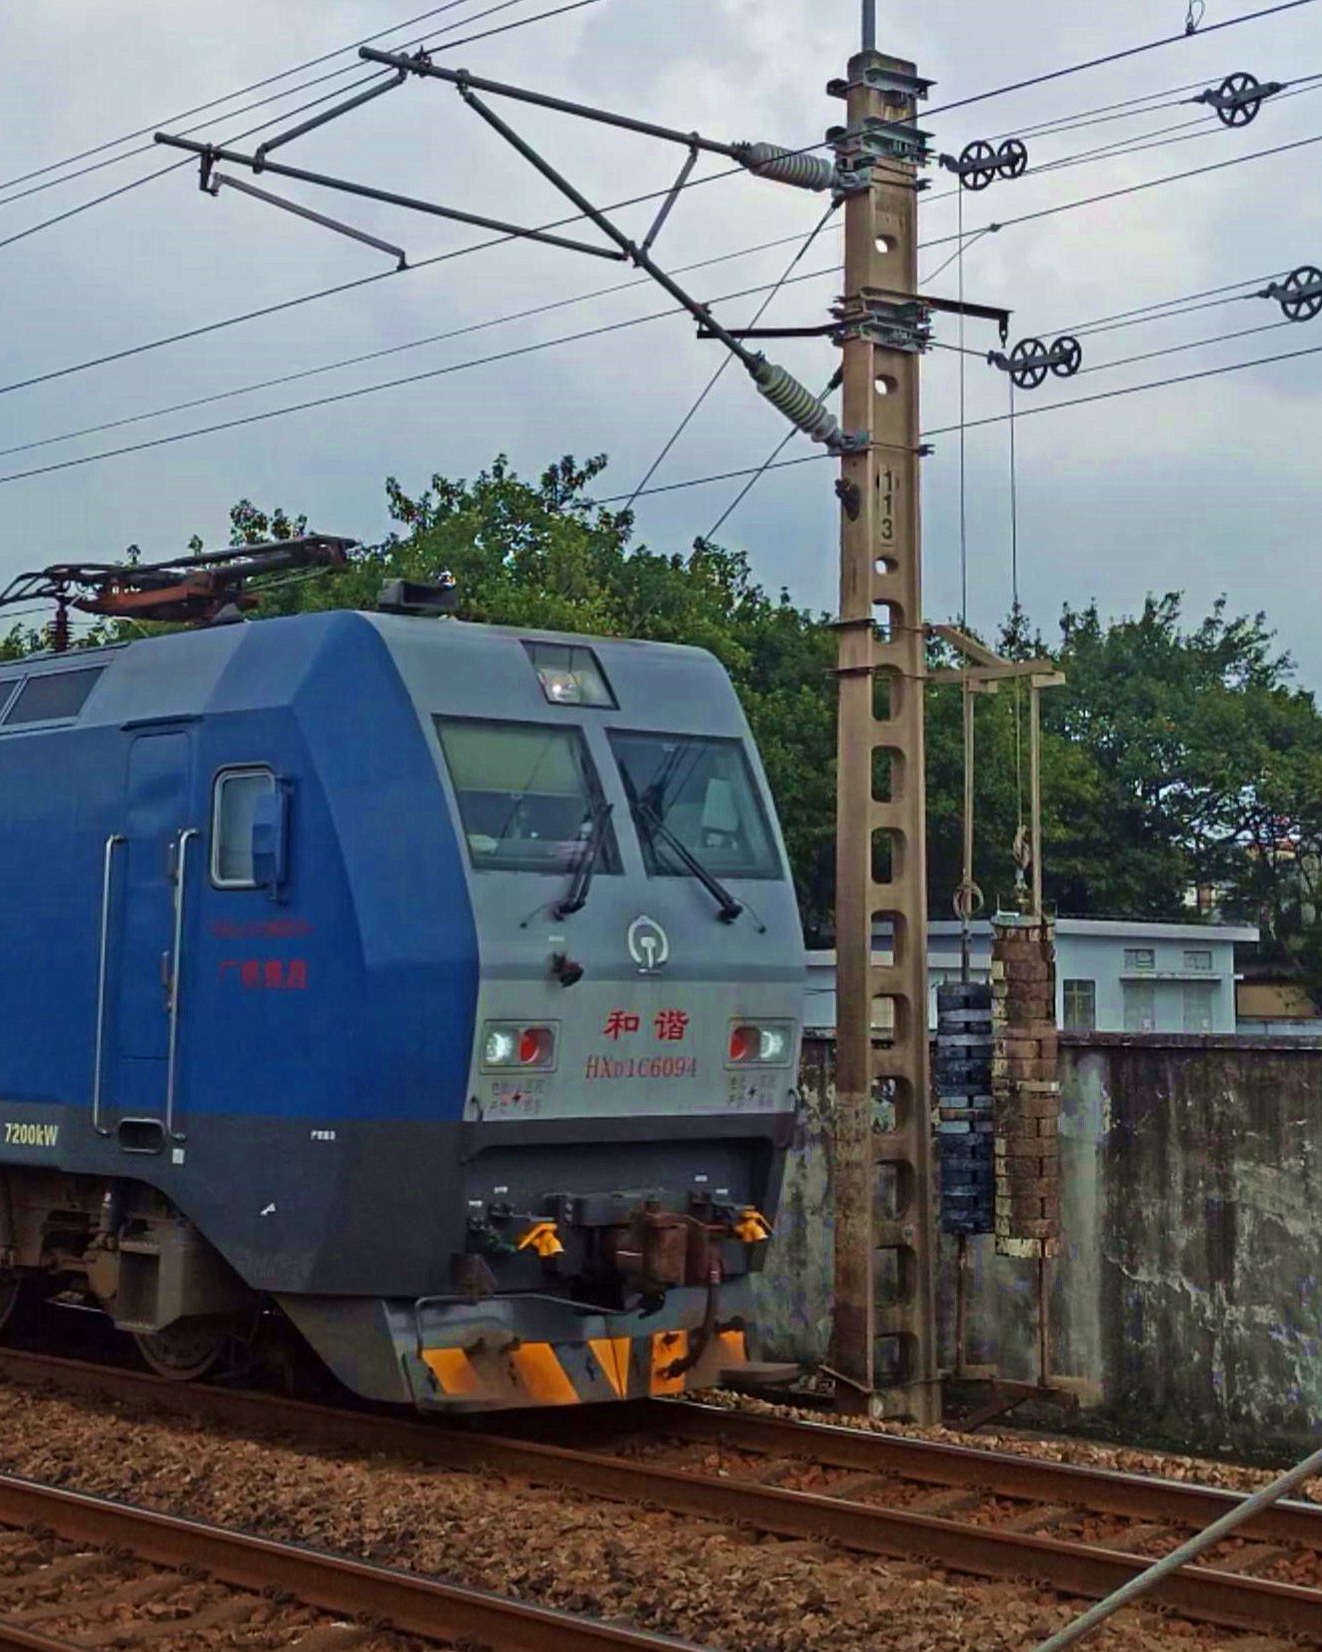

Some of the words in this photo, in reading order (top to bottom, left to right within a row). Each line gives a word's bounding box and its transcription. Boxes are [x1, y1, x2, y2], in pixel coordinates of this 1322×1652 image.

[881, 470, 893, 539] 113
[603, 1008, 689, 1041] 和谐
[4, 1123, 59, 1146] 7200kW
